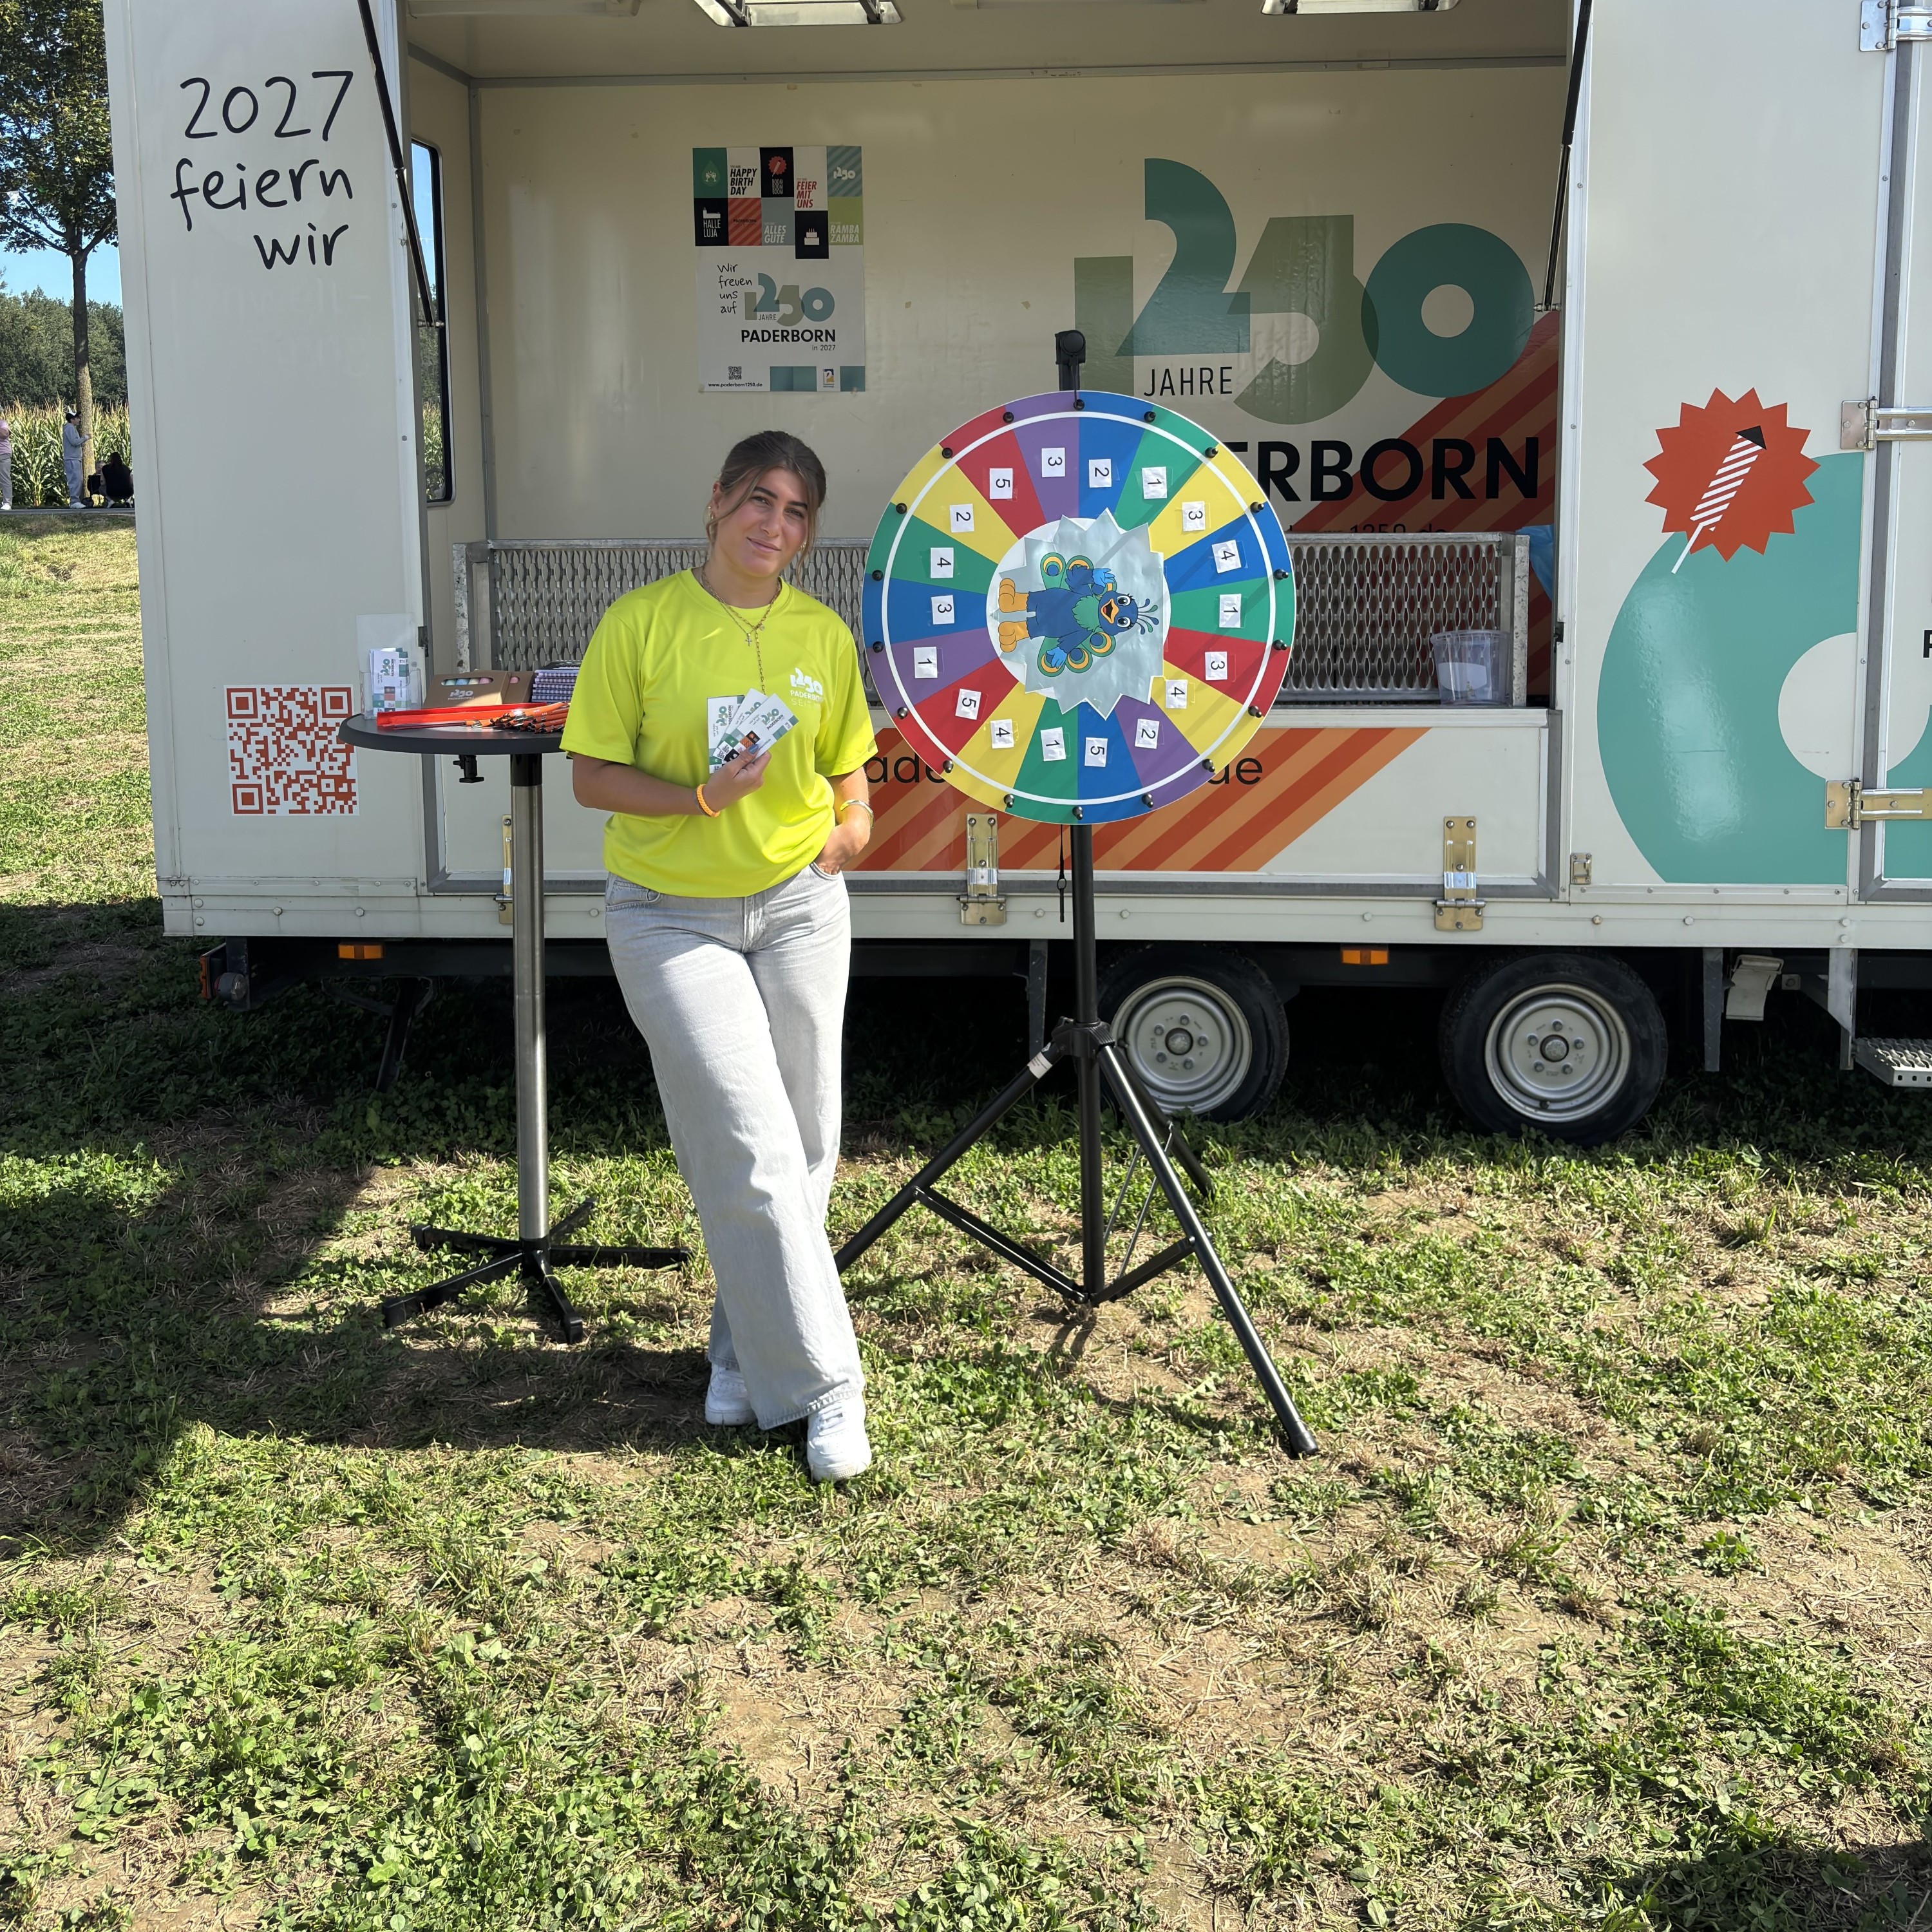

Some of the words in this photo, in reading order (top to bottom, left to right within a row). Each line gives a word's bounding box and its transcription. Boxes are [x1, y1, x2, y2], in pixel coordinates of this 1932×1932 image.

[180, 71, 354, 142] 2027
[730, 168, 757, 177] HAPPY
[833, 166, 856, 180] 1250
[730, 178, 753, 186] BIRTH
[797, 181, 817, 190] FEIER
[170, 158, 353, 232] feiern
[730, 187, 746, 195] DAY
[797, 190, 812, 199] MIT
[797, 199, 813, 208] UNS
[703, 219, 721, 228] HALLE
[703, 229, 718, 238] LUJA
[764, 225, 786, 234] ALLES
[830, 225, 859, 234] RAMBA
[764, 234, 785, 243] GUTE
[830, 234, 860, 243] ZAMBA
[253, 222, 349, 270] wir
[717, 263, 738, 273] Wir
[718, 275, 753, 289] freuen
[719, 290, 738, 299] uns
[1074, 158, 1535, 425] 1250
[744, 272, 835, 327] 1250
[720, 301, 737, 314] auf
[741, 329, 836, 343] PADERBORN
[1143, 366, 1233, 397] JAHRE
[1047, 457, 1063, 466] 3
[1094, 467, 1110, 477] 2
[1222, 437, 1539, 502] RBORN
[996, 478, 1010, 489] 5
[956, 511, 971, 522] 2
[1188, 510, 1203, 520] 3
[1221, 551, 1235, 561] 4
[936, 557, 952, 567] 4
[937, 603, 952, 614] 3
[1210, 661, 1226, 670] 3
[790, 667, 823, 696] 1250
[450, 689, 474, 697] 1250
[790, 690, 824, 703] PADERBO
[1171, 687, 1185, 697] 4
[961, 697, 977, 708] 5
[766, 714, 784, 730] PADERBORN
[996, 727, 1010, 737] 4
[1141, 728, 1156, 739] 2
[1090, 746, 1105, 755] 5
